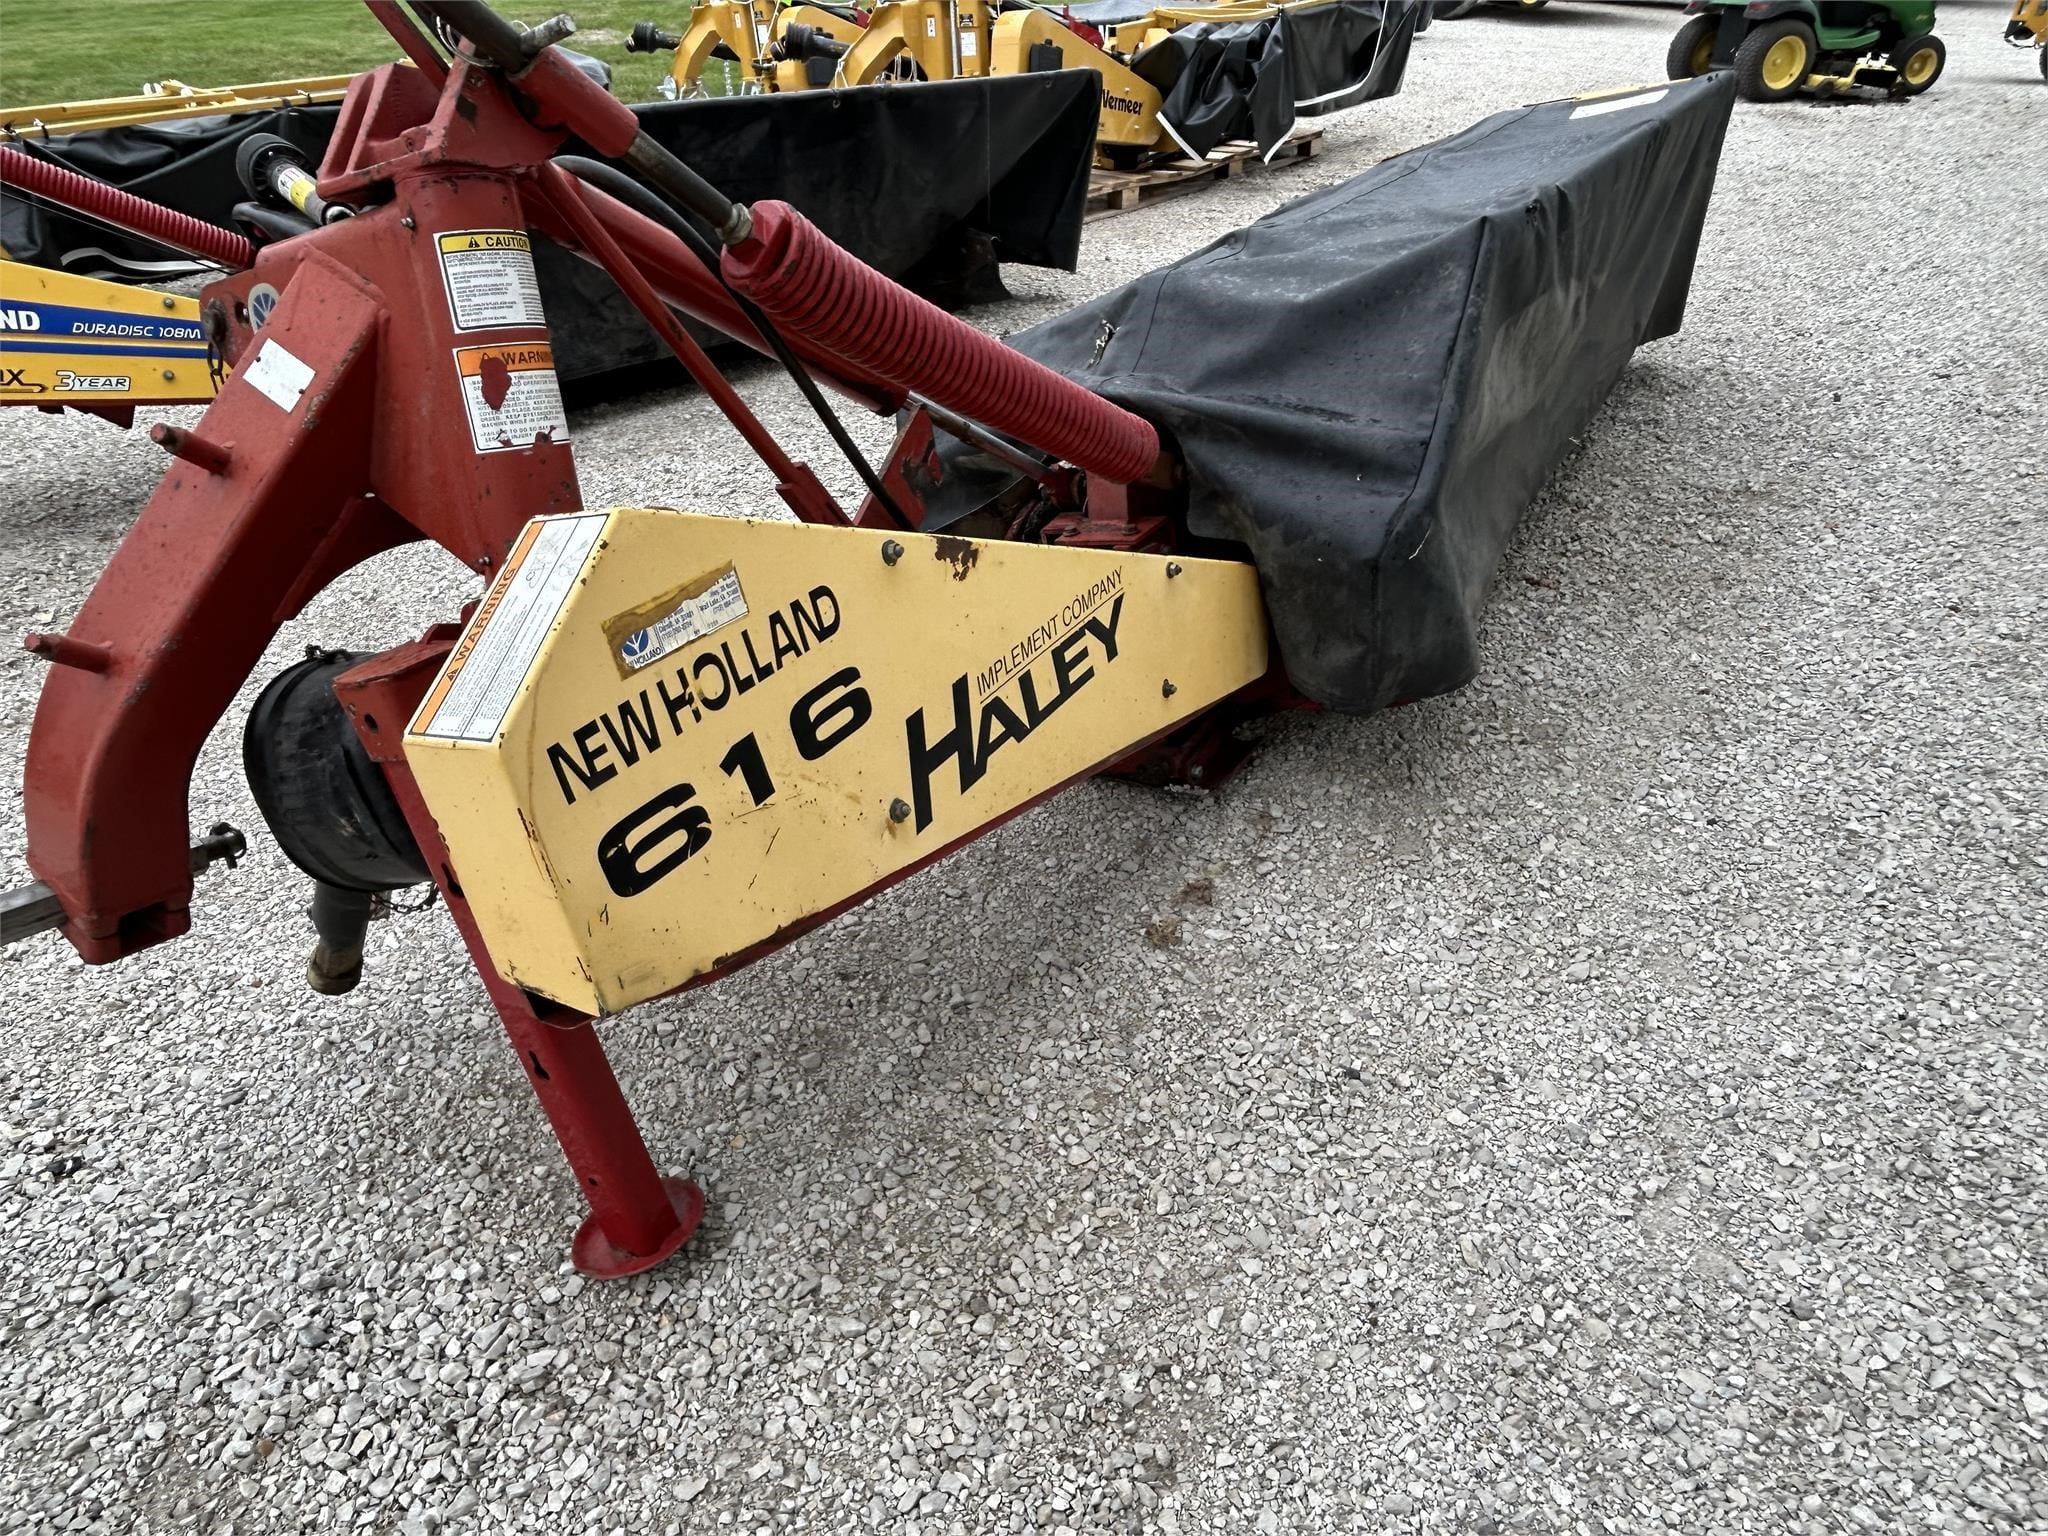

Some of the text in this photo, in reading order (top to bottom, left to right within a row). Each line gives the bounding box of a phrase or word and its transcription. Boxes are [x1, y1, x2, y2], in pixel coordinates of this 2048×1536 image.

[1102, 88, 1143, 116] Vermeer
[485, 236, 529, 249] CAUTION
[72, 321, 200, 339] DURADISC 108M
[77, 378, 127, 388] YEAR
[456, 568, 516, 662] WARNING
[976, 565, 1123, 696] IMPLEMENT COMPANY
[546, 689, 661, 805] NEW
[656, 585, 841, 736] HOLLAND
[905, 592, 1125, 836] HALEY
[597, 666, 872, 898] 616
